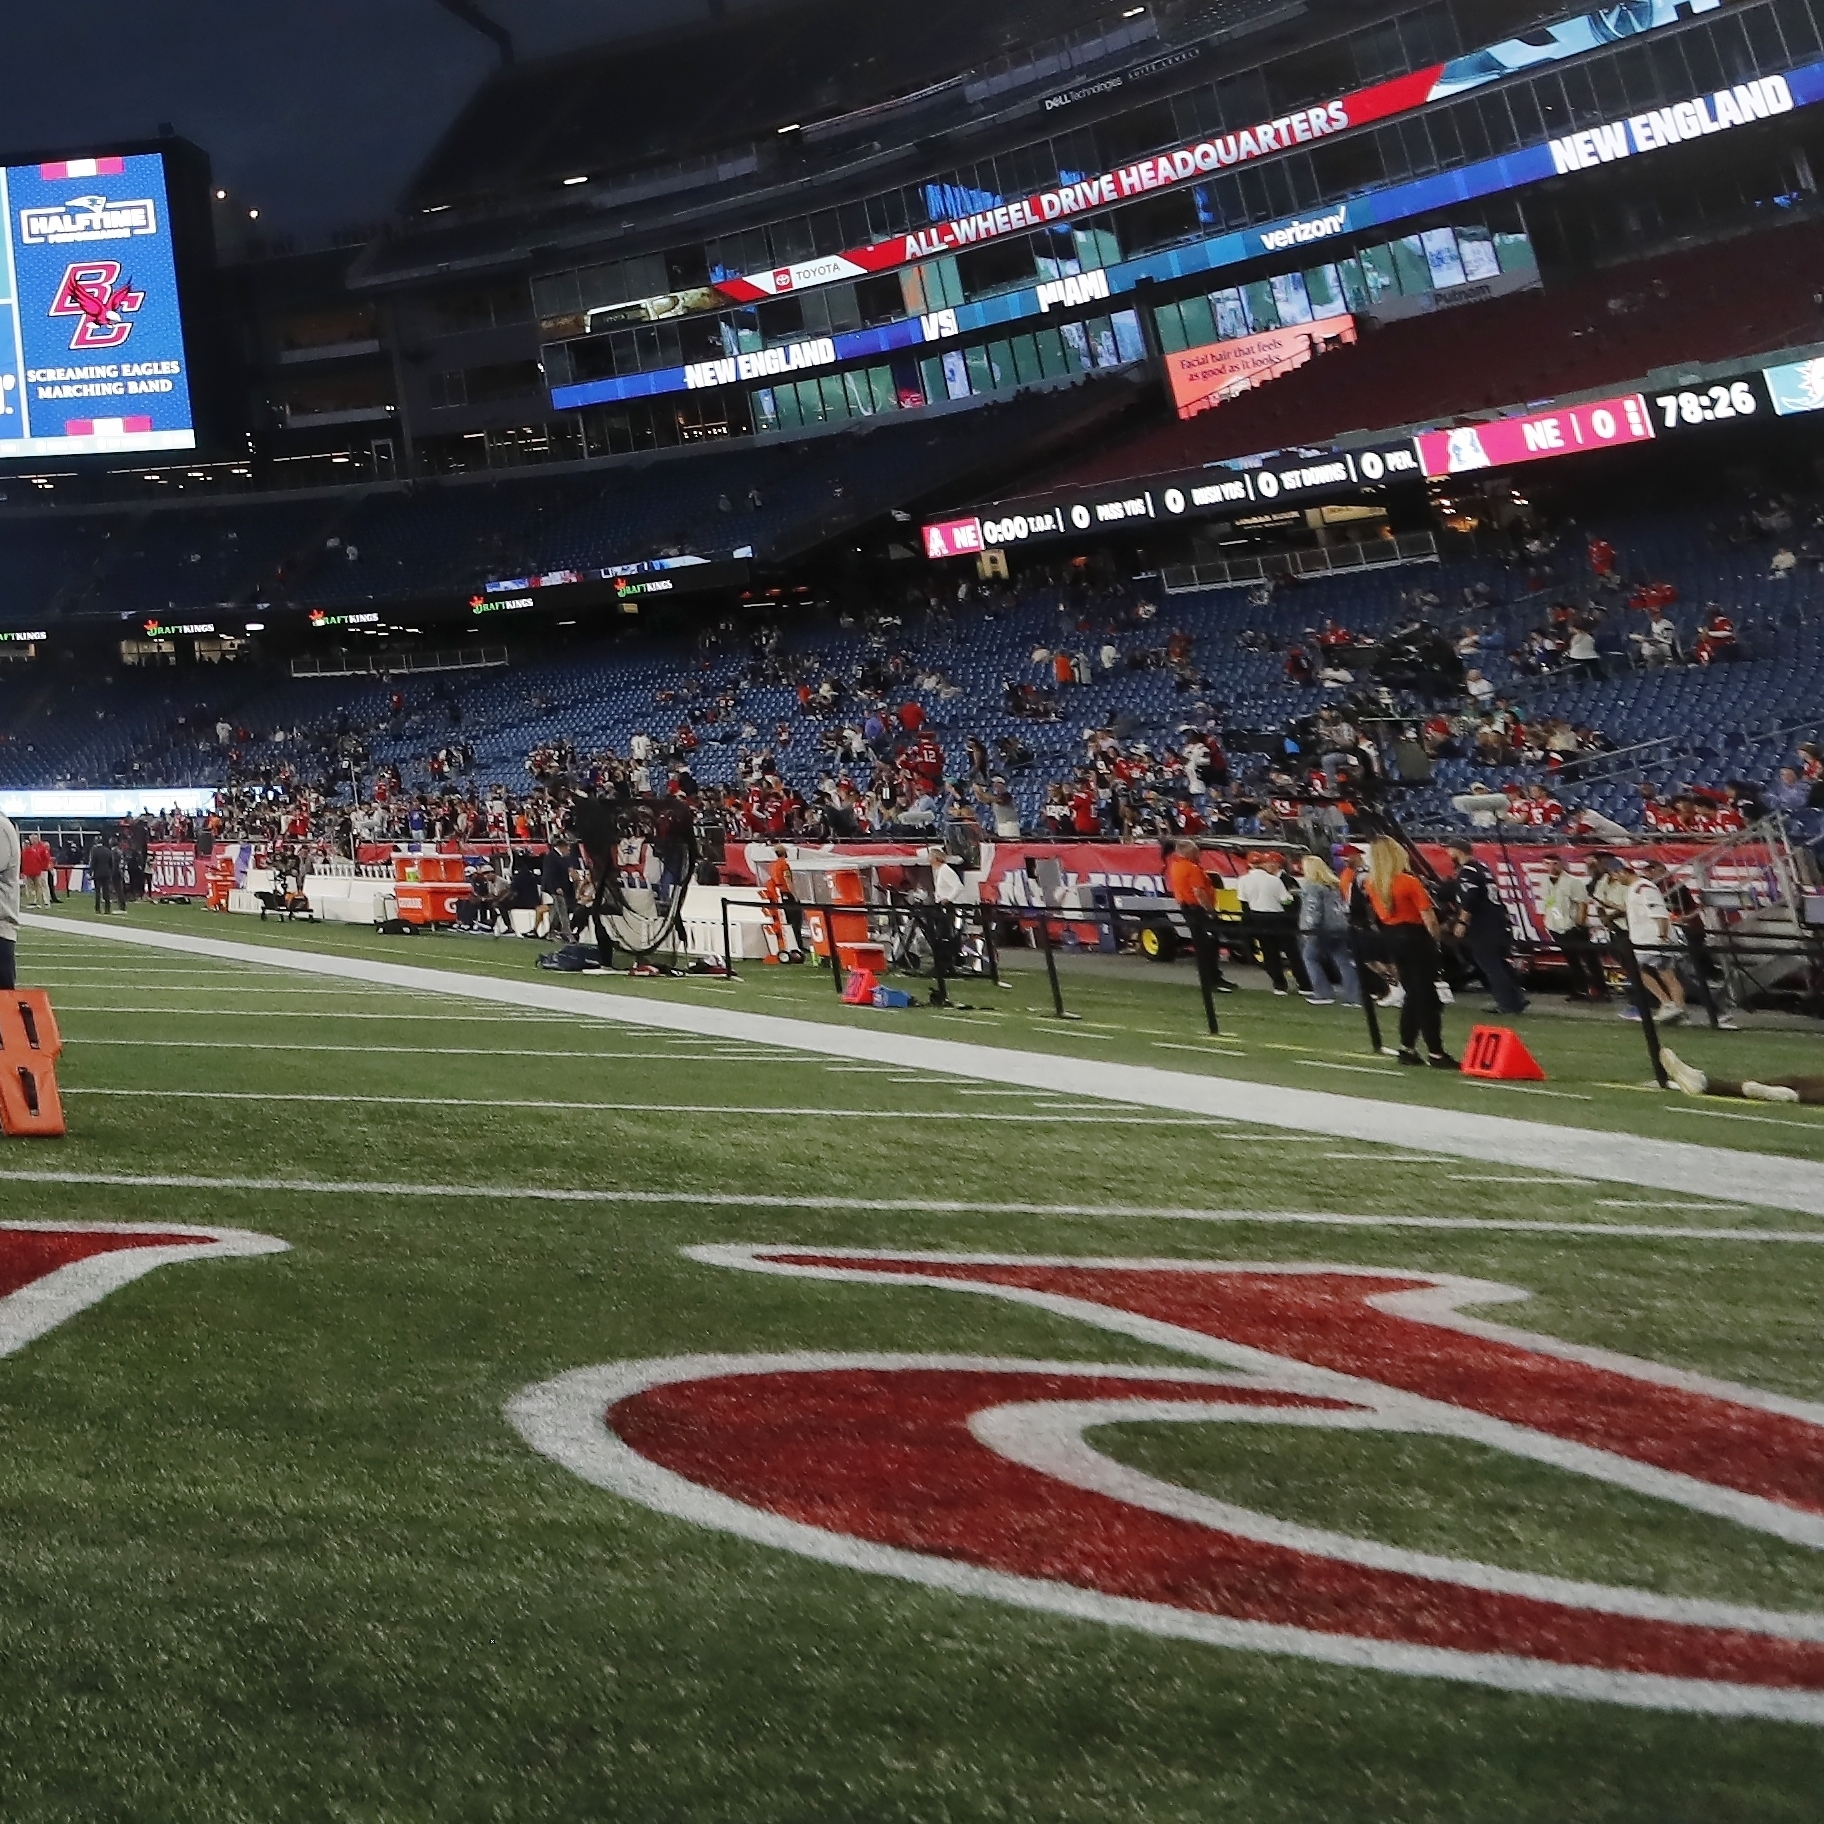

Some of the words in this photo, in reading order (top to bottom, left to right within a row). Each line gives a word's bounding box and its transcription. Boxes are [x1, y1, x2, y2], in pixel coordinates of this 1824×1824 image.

[1044, 93, 1071, 112] DELL
[1549, 120, 1630, 175] NEW
[1629, 73, 1795, 154] ENGLAND
[905, 199, 1040, 261] ALL-WHEEL
[1039, 172, 1116, 222] DRIVE
[1117, 99, 1350, 200] HEADQUARTERS
[29, 208, 148, 236] HALFTIME
[1260, 217, 1343, 251] verizon
[795, 262, 841, 282] TOYOTA
[684, 352, 739, 389] NEW
[738, 337, 836, 381] ENGLAND
[920, 309, 956, 341] VS
[1035, 268, 1109, 313] MIAMI
[1179, 354, 1209, 370] Facial
[1210, 347, 1233, 363] hair
[1232, 344, 1256, 358] that
[1257, 338, 1284, 351] feels
[1188, 373, 1200, 382] as
[1201, 363, 1228, 382] good
[1228, 363, 1241, 373] as
[1251, 353, 1283, 368] looks
[27, 366, 118, 384] SCREAMING
[119, 360, 181, 379] EAGLES
[37, 383, 124, 401] MARCHING
[126, 378, 173, 396] BAND
[1656, 381, 1755, 429] 78:26
[1524, 419, 1564, 451] NE
[1592, 409, 1617, 438] 0
[953, 525, 978, 551] NE
[983, 513, 1028, 543] 0:00
[1027, 513, 1057, 536] T.O.P.
[1071, 503, 1090, 529] 0
[1095, 501, 1124, 522] PASS
[1124, 496, 1146, 517] YDS
[1165, 488, 1184, 514] 0
[1192, 484, 1222, 506] RUSH
[1221, 480, 1245, 501] YDS
[1257, 472, 1278, 497] 0
[1281, 467, 1303, 490] 1ST
[1302, 461, 1346, 485] DOWNS
[1362, 452, 1384, 479] 0
[1385, 450, 1416, 473] PEN.
[616, 579, 673, 597] DRAFTKINGS
[472, 597, 534, 614] DRAFTKINGS
[145, 622, 215, 637] DRAFTKINGS
[922, 750, 938, 764] 12
[809, 915, 822, 943] G
[1471, 1032, 1501, 1070] 10
